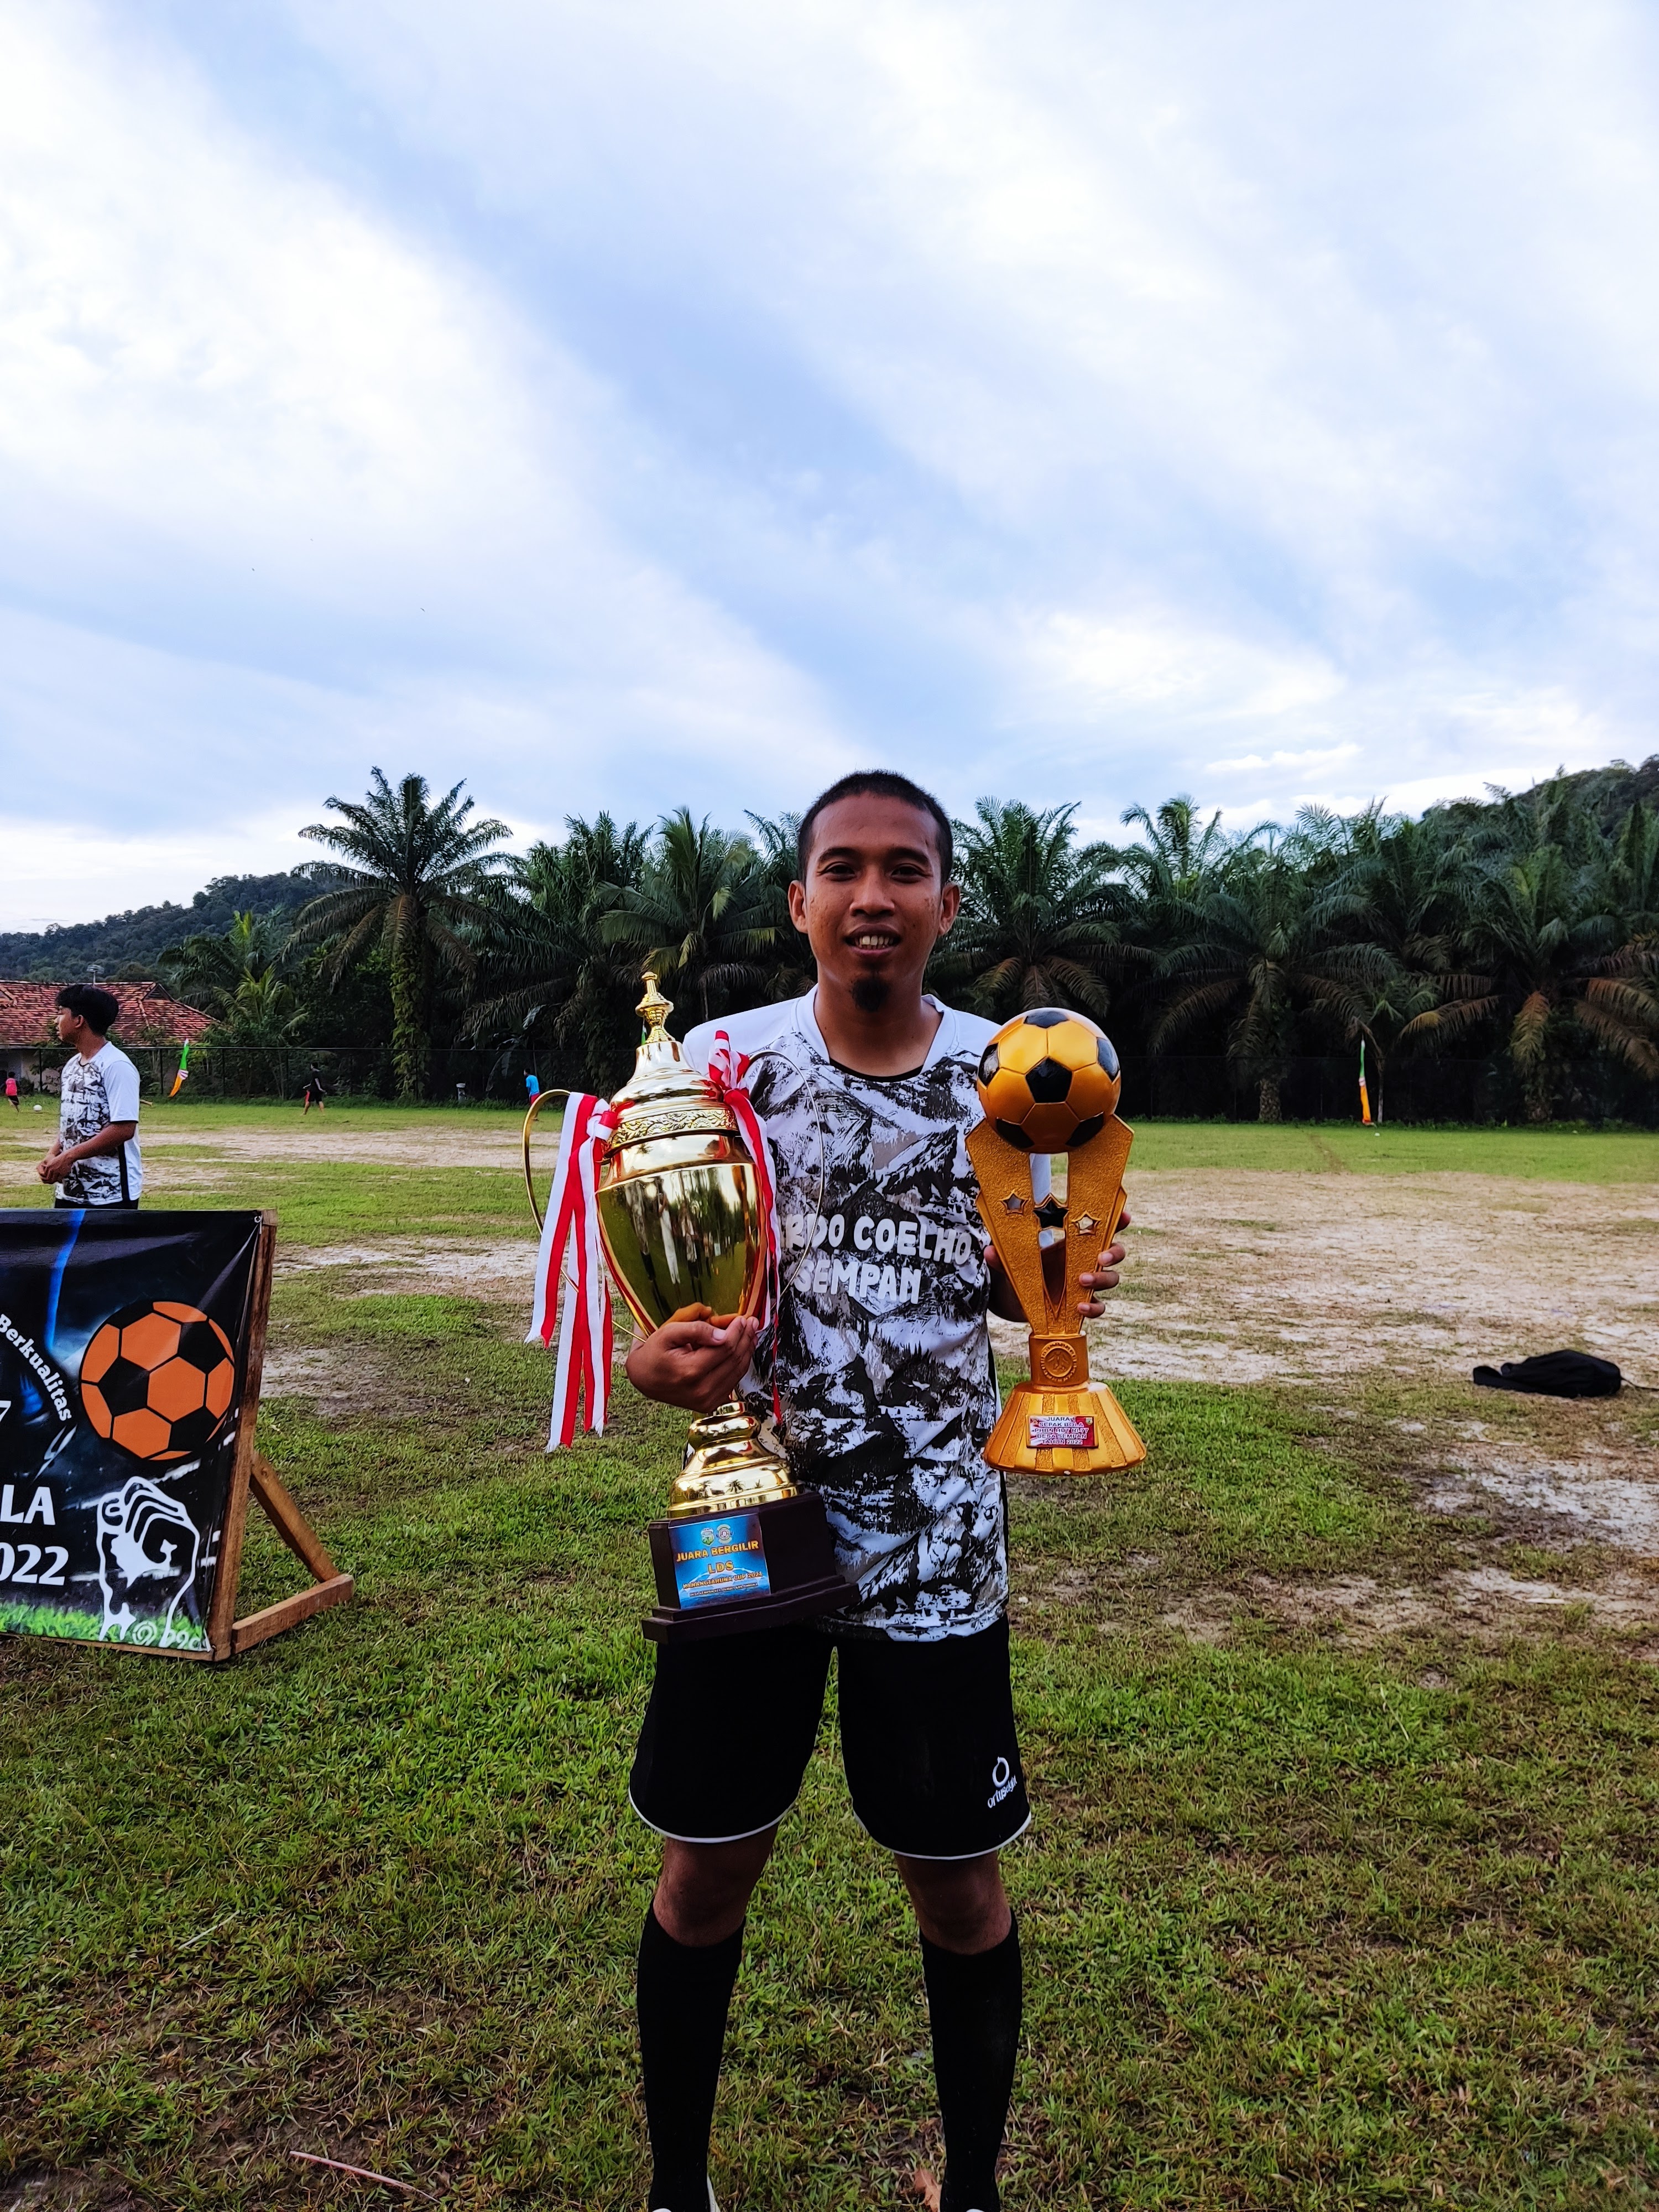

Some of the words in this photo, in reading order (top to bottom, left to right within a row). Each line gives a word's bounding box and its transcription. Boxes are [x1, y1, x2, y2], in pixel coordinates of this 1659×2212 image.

[853, 1215, 972, 1265] COELHO
[793, 1258, 922, 1304] SEMPAN
[0, 1313, 72, 1421] Berkualitas
[676, 1549, 709, 1562] JUARA
[711, 1541, 759, 1555] BERGILIR
[707, 1560, 734, 1574] LDS
